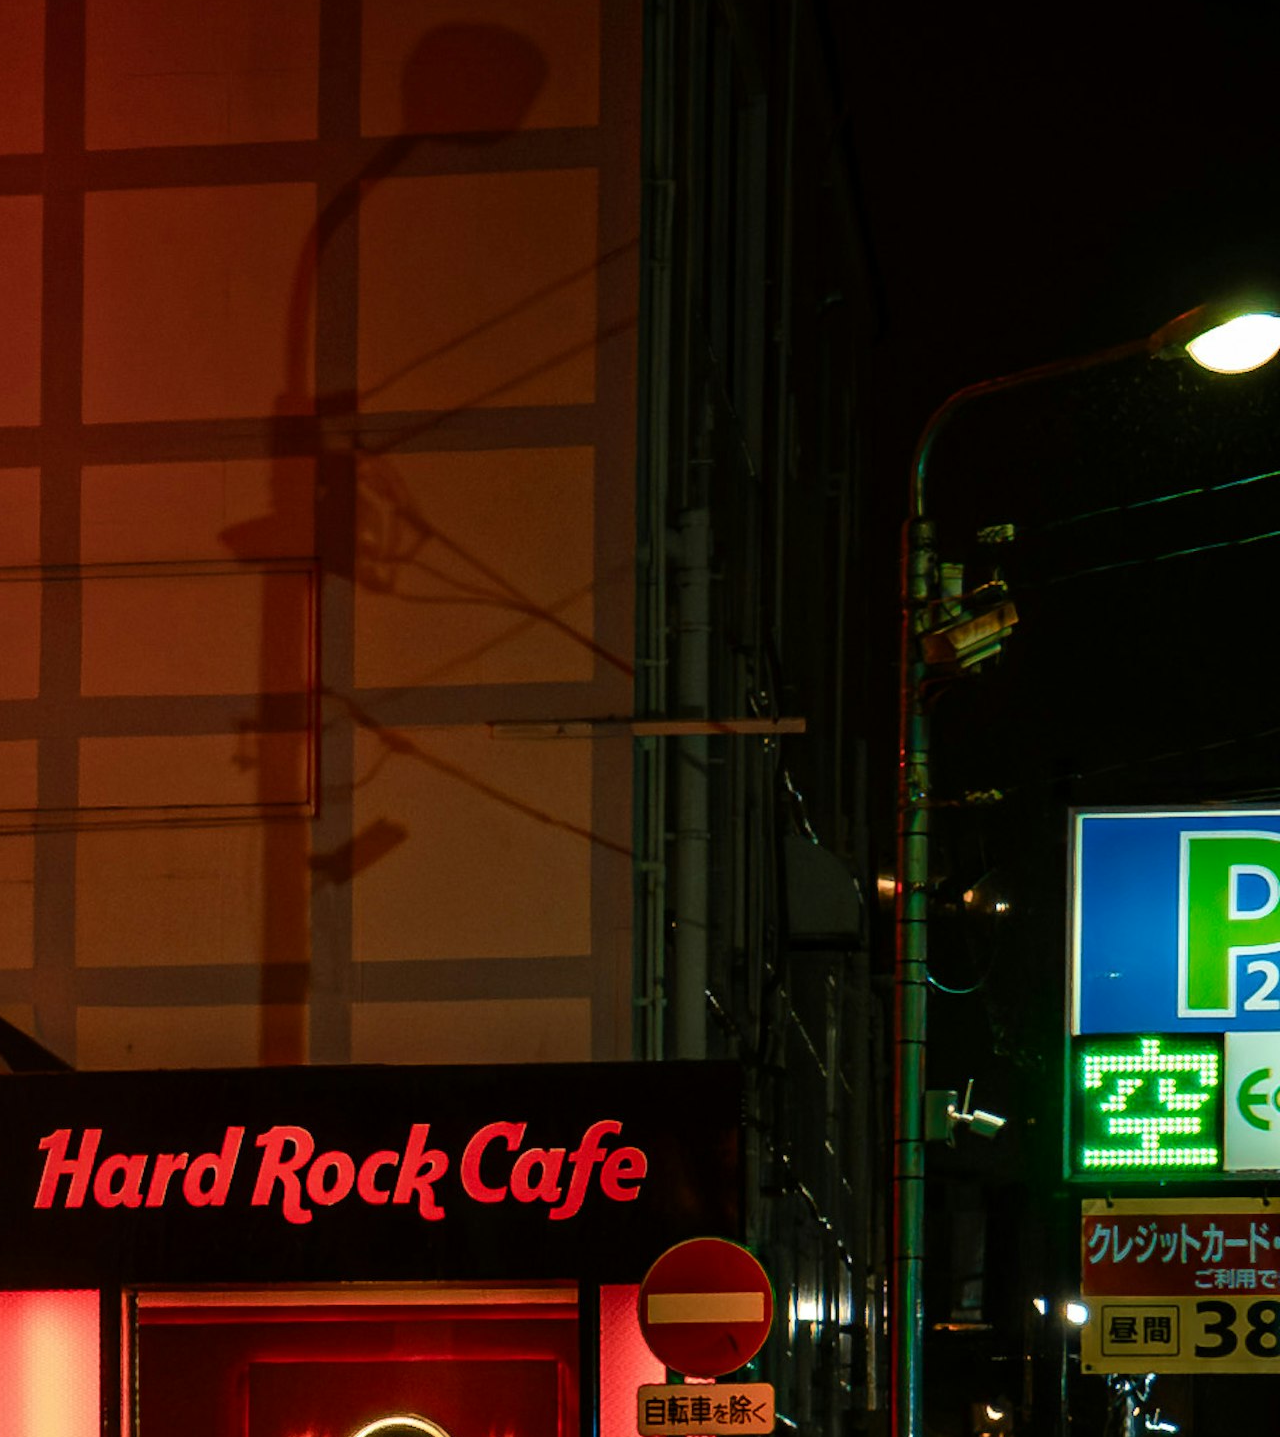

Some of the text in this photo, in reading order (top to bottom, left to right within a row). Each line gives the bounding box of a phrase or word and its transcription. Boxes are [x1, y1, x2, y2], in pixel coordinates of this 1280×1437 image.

[1178, 830, 1280, 1019] P
[1083, 1038, 1218, 1167] 空
[34, 1119, 648, 1224] Hard Rock Cafe
[1195, 1268, 1280, 1290] ご利用で
[1109, 1316, 1172, 1344] 昼間
[644, 1395, 767, 1426] 自転車を除く
